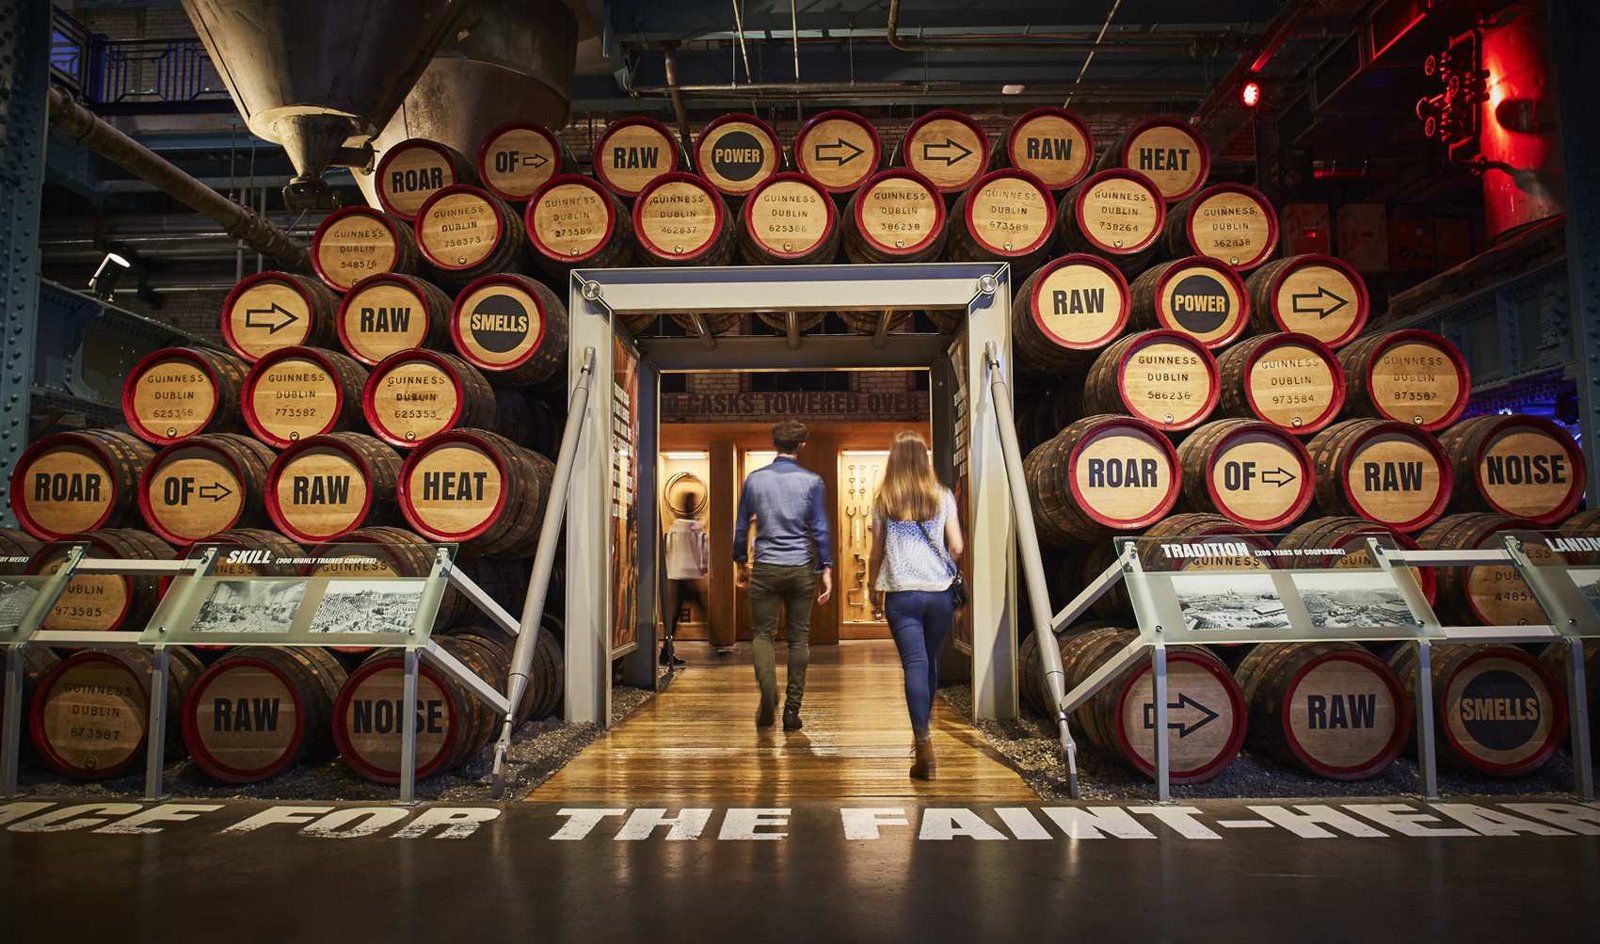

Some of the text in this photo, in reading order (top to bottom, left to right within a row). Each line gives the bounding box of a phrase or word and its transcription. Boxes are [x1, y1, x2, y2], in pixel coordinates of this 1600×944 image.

[1027, 137, 1072, 162] RAW
[613, 147, 659, 170] RAW
[715, 148, 760, 164] POWER
[1140, 148, 1190, 172] HEAT
[495, 151, 519, 173] OF
[392, 168, 443, 193] ROAR
[652, 195, 704, 204] GUINNESS
[763, 195, 815, 203] GUINNESS
[874, 191, 925, 201] GUINNESS
[985, 189, 1037, 202] GUINNESS
[1095, 190, 1146, 203] GUINNESS
[545, 197, 596, 208] GUINNESS
[434, 206, 484, 219] GUINNESS
[660, 210, 697, 218] DUBLIN
[771, 209, 808, 218] DUBLIN
[881, 206, 918, 216] DUBLIN
[990, 205, 1027, 216] DUBLIN
[1101, 205, 1138, 216] DUBLIN
[1204, 207, 1255, 218] GUINNESS
[554, 212, 590, 221] DUBLIN
[442, 221, 478, 233] DUBLIN
[661, 226, 697, 235] 462837
[768, 224, 806, 233] 625386
[880, 222, 920, 231] 386238
[989, 221, 1028, 231] 673589
[1100, 222, 1139, 233] 738264
[1212, 221, 1249, 232] DUBLIN
[334, 230, 384, 239] GUINNESS
[445, 237, 482, 248] 758373
[1213, 238, 1251, 248] 362838
[339, 245, 376, 253] DUBLIN
[340, 260, 377, 269] 548576
[1052, 288, 1105, 315] RAW
[1175, 294, 1226, 313] POWER
[360, 307, 411, 333] RAW
[471, 313, 528, 334] SMELLS
[1138, 356, 1197, 365] GUINNESS
[1261, 358, 1320, 370] GUINNESS
[1384, 356, 1443, 367] GUINNESS
[147, 374, 204, 384] GUINNESS
[268, 373, 325, 382] GUINNESS
[388, 376, 445, 386] GUINNESS
[1147, 373, 1189, 382] DUBLIN
[1270, 376, 1312, 386] DUBLIN
[1394, 372, 1435, 382] DUBLIN
[154, 391, 194, 400] DUBLIN
[275, 389, 316, 399] DUBLIN
[396, 392, 438, 402] DUBLIN
[1148, 390, 1191, 400] 586236
[1272, 394, 1314, 405] 973584
[763, 392, 860, 414] TOWERED
[868, 392, 920, 414] OVER
[274, 407, 317, 418] 773582
[1088, 458, 1158, 489] ROAR
[1487, 455, 1567, 485] NOISE
[1225, 461, 1256, 491] OF
[1364, 461, 1423, 492] RAW
[34, 473, 101, 502] ROAR
[164, 477, 195, 506] OF
[293, 476, 350, 505] RAW
[423, 471, 488, 501] HEAT
[1161, 543, 1250, 558] TRADITION
[227, 550, 272, 564] SKILL
[1193, 556, 1260, 567] GUINNESS
[323, 561, 387, 572] GUINNESS
[68, 585, 104, 595] UBLIN
[54, 606, 102, 617] 973585
[64, 683, 133, 698] GUINNESS
[72, 704, 121, 718] DUBLIN
[1308, 694, 1375, 730] RAW
[1461, 696, 1538, 722] SMELLS
[214, 698, 280, 733] RAW
[217, 806, 502, 839] FOR
[552, 808, 791, 841] THE
